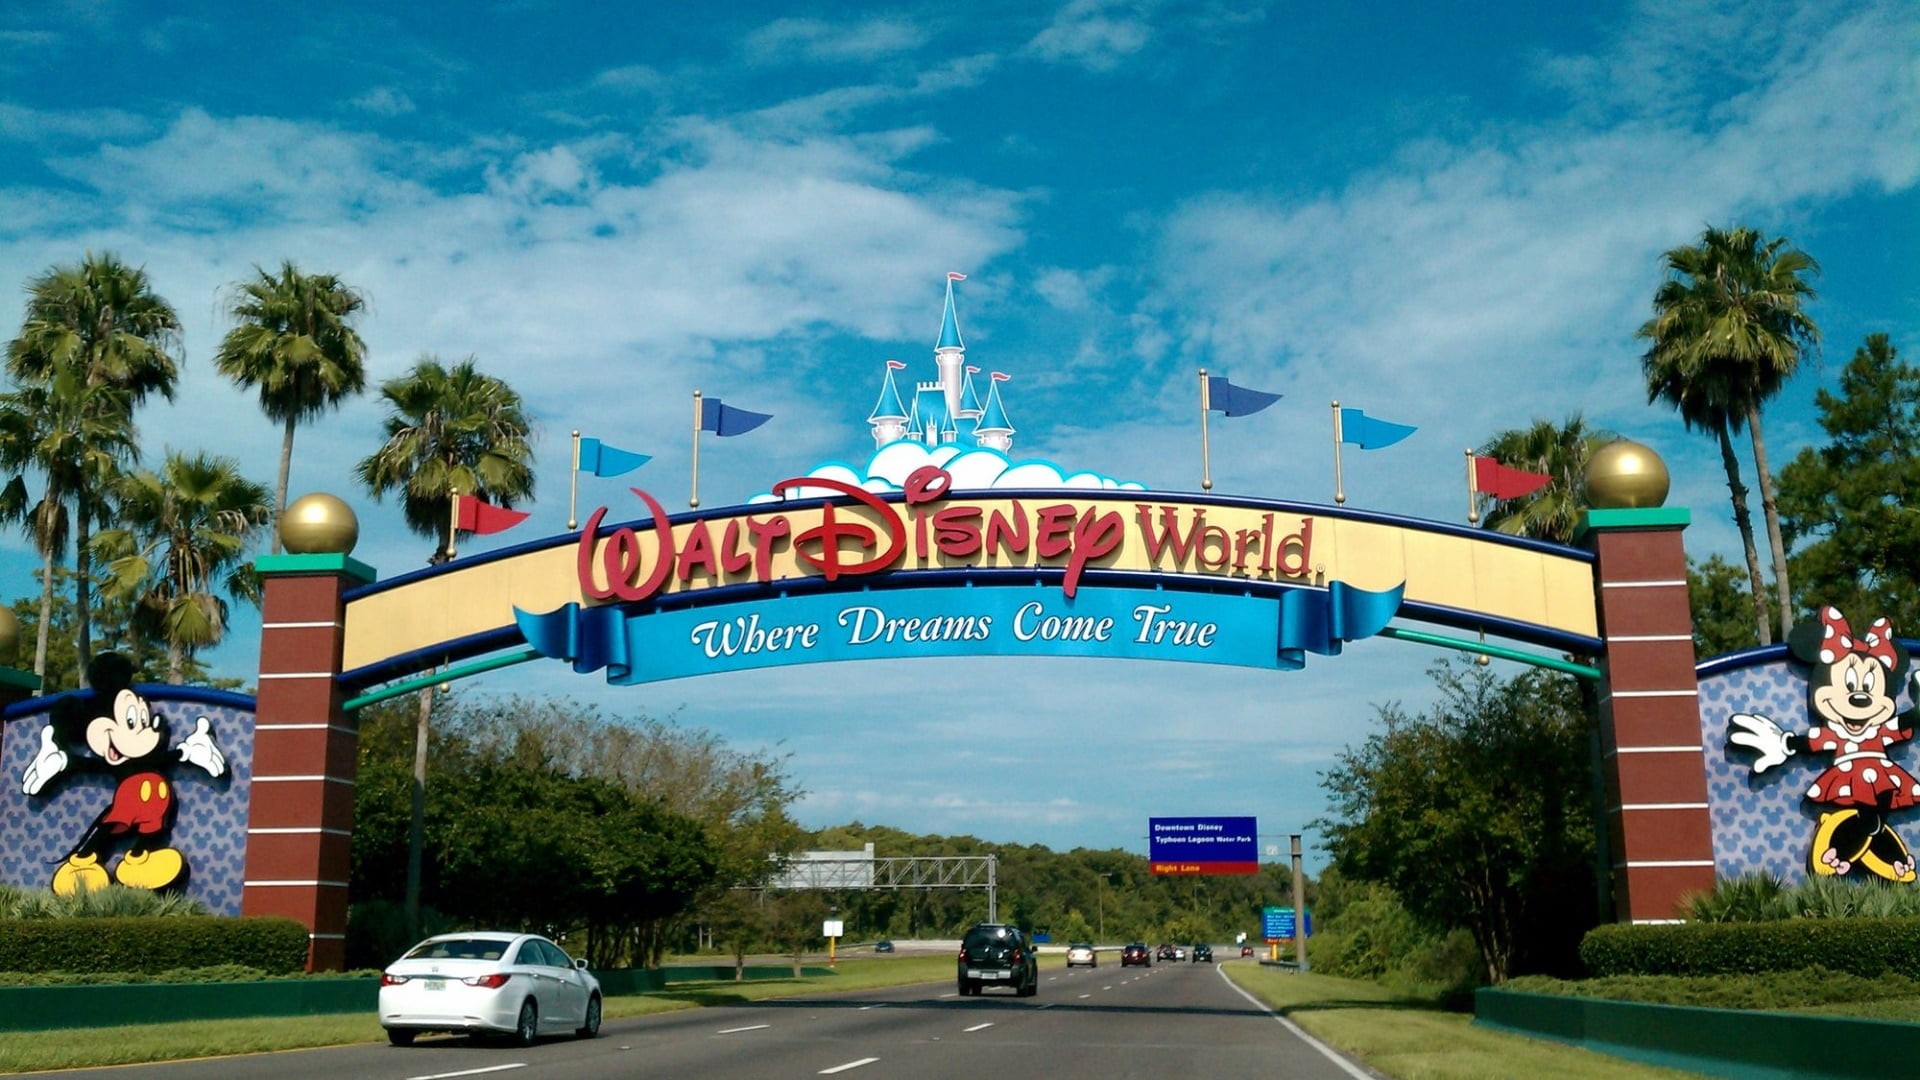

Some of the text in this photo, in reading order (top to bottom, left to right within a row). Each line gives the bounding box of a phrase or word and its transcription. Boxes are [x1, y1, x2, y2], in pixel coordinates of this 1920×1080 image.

[577, 487, 790, 601] WALT
[691, 602, 1217, 659] Where Dreams Come True
[1155, 836, 1187, 844] Typhoon
[1187, 836, 1215, 844] Lagoon
[1156, 864, 1200, 872] Right Lane
